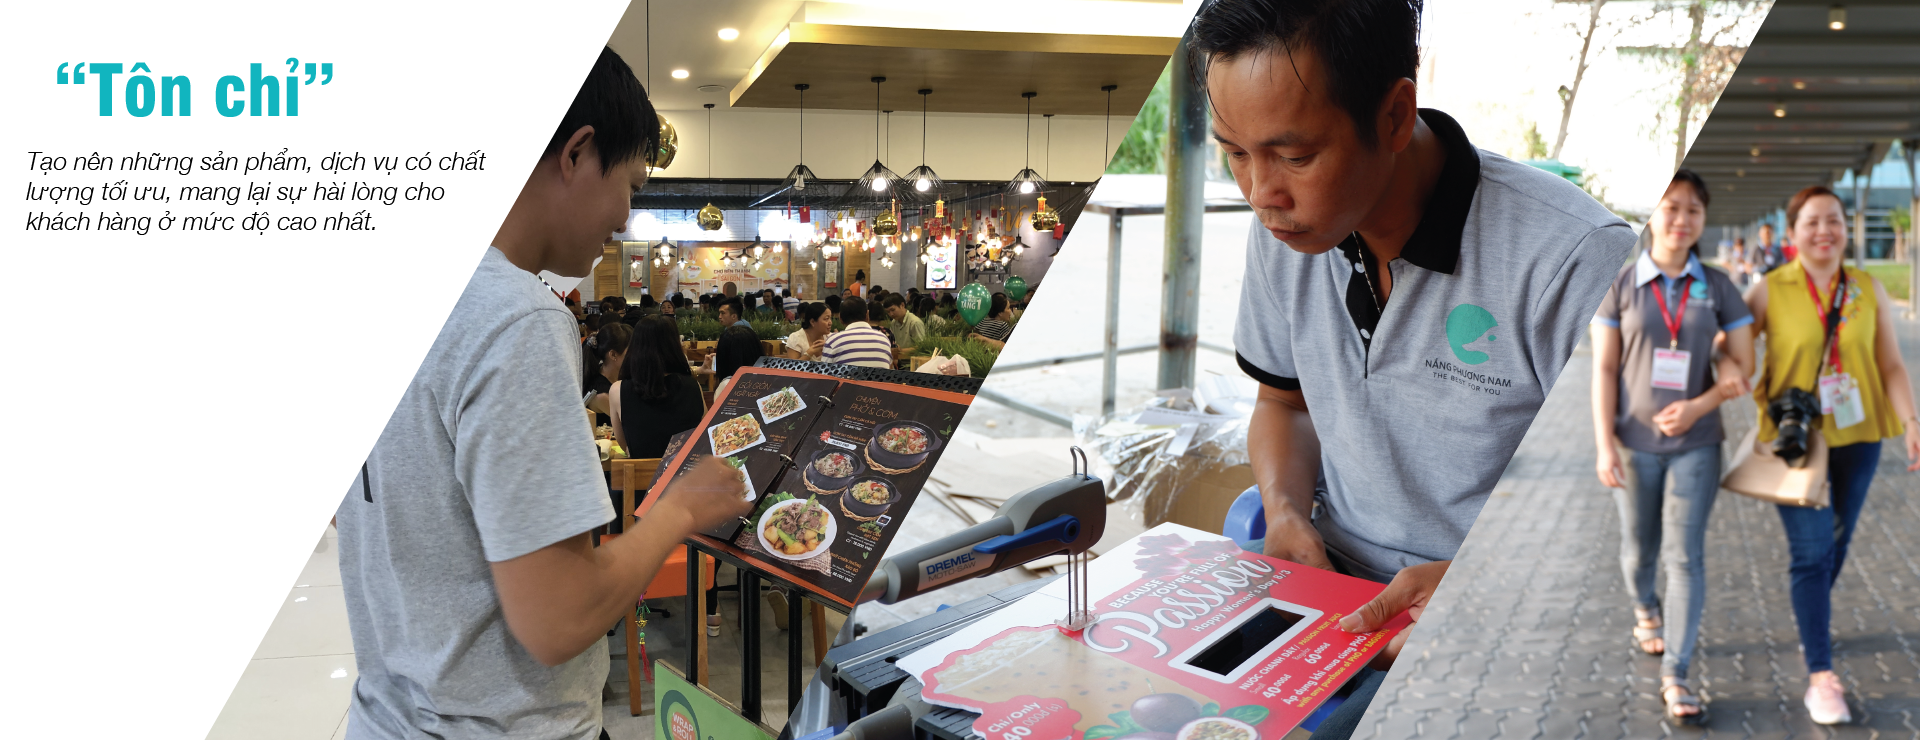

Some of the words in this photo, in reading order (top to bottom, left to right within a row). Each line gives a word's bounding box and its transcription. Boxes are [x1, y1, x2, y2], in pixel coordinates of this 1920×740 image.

[1433, 371, 1448, 380] THE
[1450, 374, 1466, 386] BEST
[1468, 382, 1481, 392] FOR
[1483, 387, 1501, 396] YOU
[1487, 375, 1512, 388] NAM
[868, 407, 875, 416] &
[926, 552, 975, 575] DREMEL
[928, 561, 976, 582] MOTO-SAW
[1148, 574, 1194, 598] YOU'RE
[1192, 560, 1220, 577] FULL
[1214, 552, 1233, 564] OF
[1083, 559, 1273, 659] Passion
[1108, 578, 1165, 609] BECAUSE
[1191, 612, 1226, 633] Happy
[1225, 588, 1262, 615] Women's
[1259, 578, 1279, 593] Day
[1275, 569, 1292, 581] 8/3
[1261, 656, 1286, 675] CHANH
[1298, 629, 1321, 646] PASSION
[1317, 620, 1332, 633] FRUIT
[1281, 694, 1299, 705] Áp
[1294, 680, 1318, 696] dụng
[1309, 670, 1326, 681] khi
[1323, 658, 1341, 672] mua
[1338, 645, 1358, 660] cùng
[1297, 696, 1313, 708] with
[1310, 686, 1325, 697] any
[1321, 667, 1346, 688] purchase
[1343, 660, 1352, 668] of
[673, 712, 694, 732] WRAP
